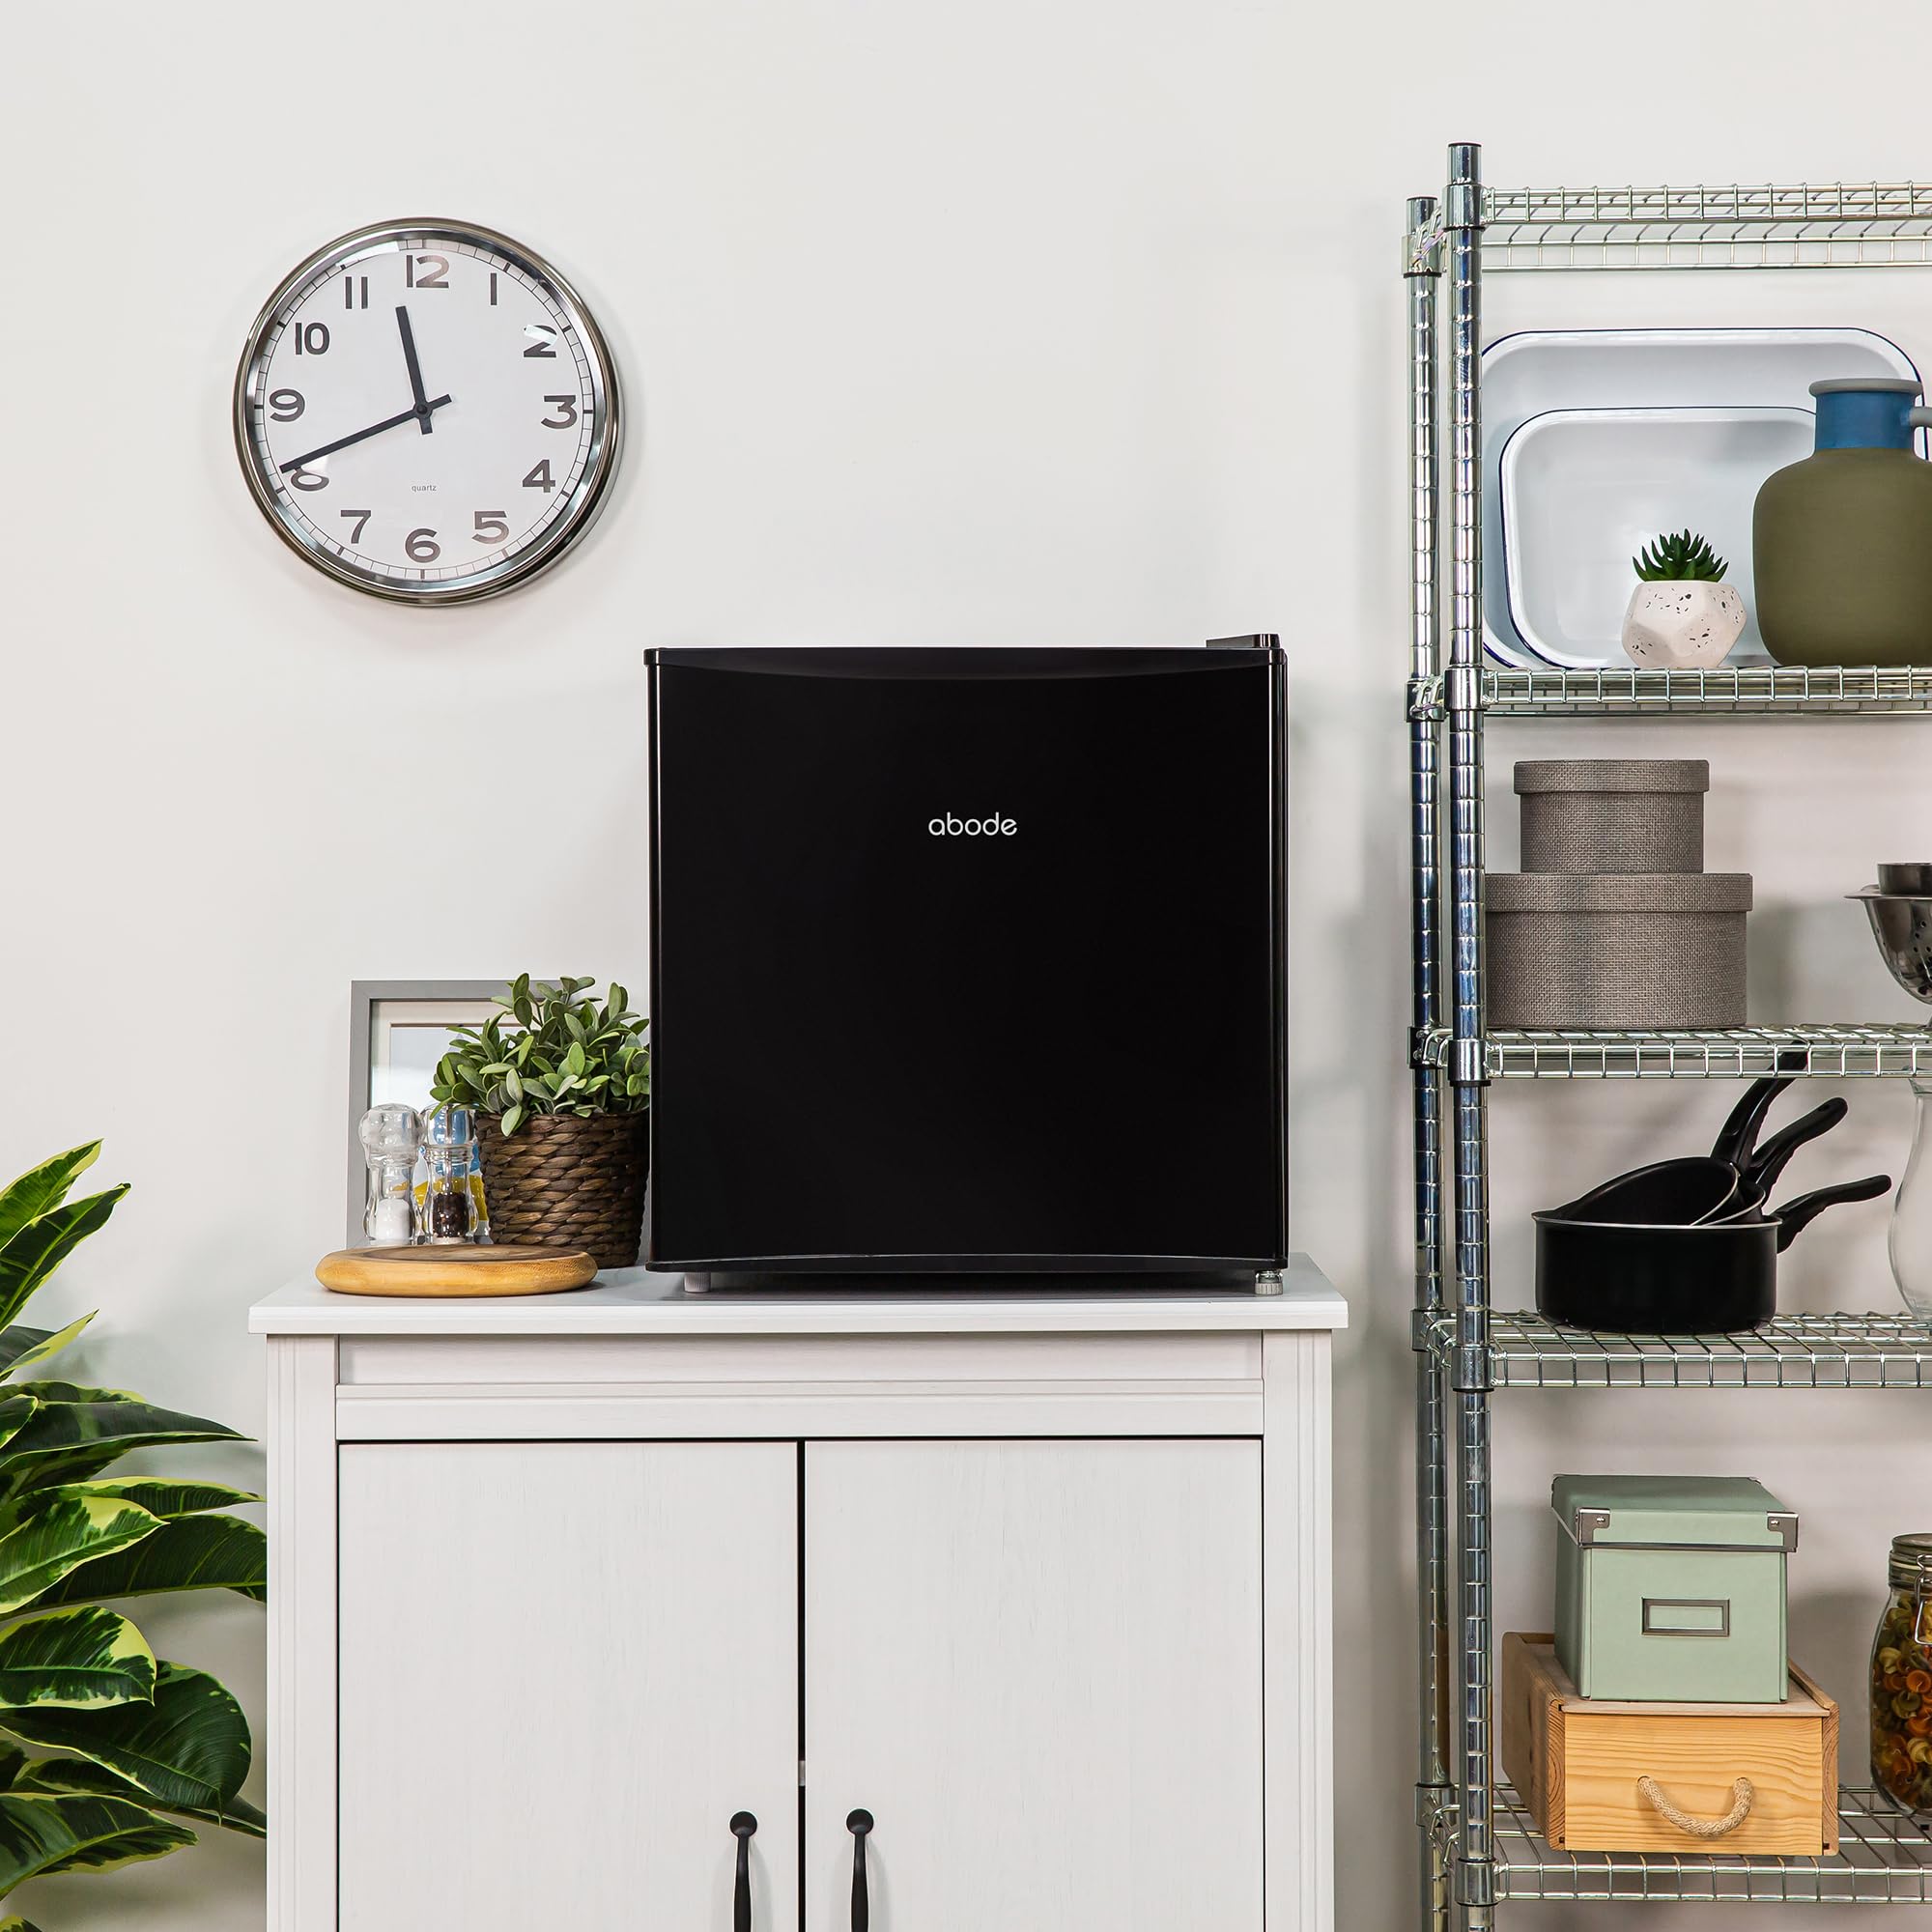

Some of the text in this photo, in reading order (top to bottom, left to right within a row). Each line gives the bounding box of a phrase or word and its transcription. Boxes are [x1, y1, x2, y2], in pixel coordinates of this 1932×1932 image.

[407, 254, 449, 289] 12
[345, 276, 368, 309] 11
[295, 322, 330, 355] 10
[269, 388, 305, 422] 9
[540, 394, 577, 430] 3
[411, 484, 437, 493] quartz
[522, 459, 555, 493] 4
[340, 509, 372, 544] 7
[471, 510, 509, 544] 5
[405, 528, 440, 563] 6
[928, 811, 1017, 836] abode
